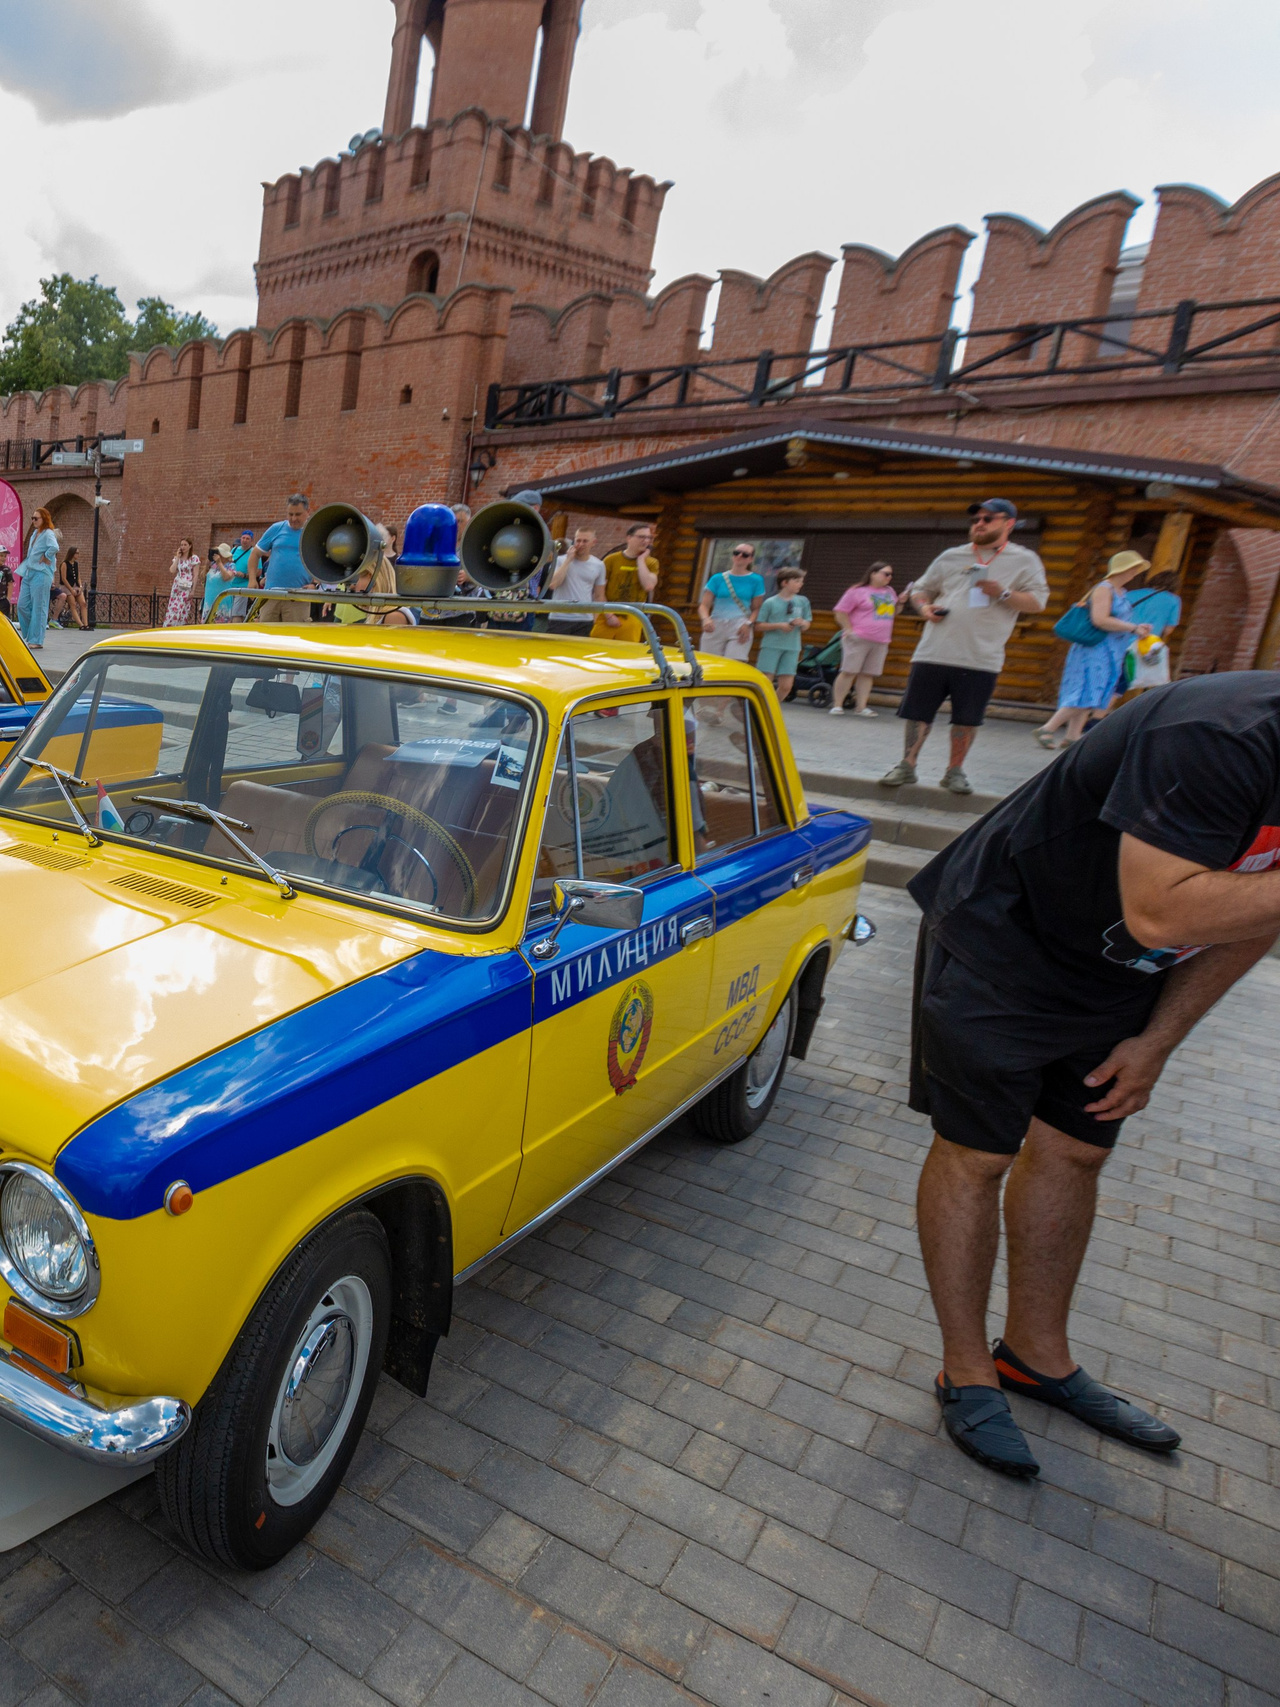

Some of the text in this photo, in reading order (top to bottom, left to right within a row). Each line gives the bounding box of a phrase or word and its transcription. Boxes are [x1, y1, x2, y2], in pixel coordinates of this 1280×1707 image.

[551, 915, 678, 1005] МИЛИЦИЯ
[726, 963, 761, 1011] МВД
[713, 1005, 757, 1056] СССР
